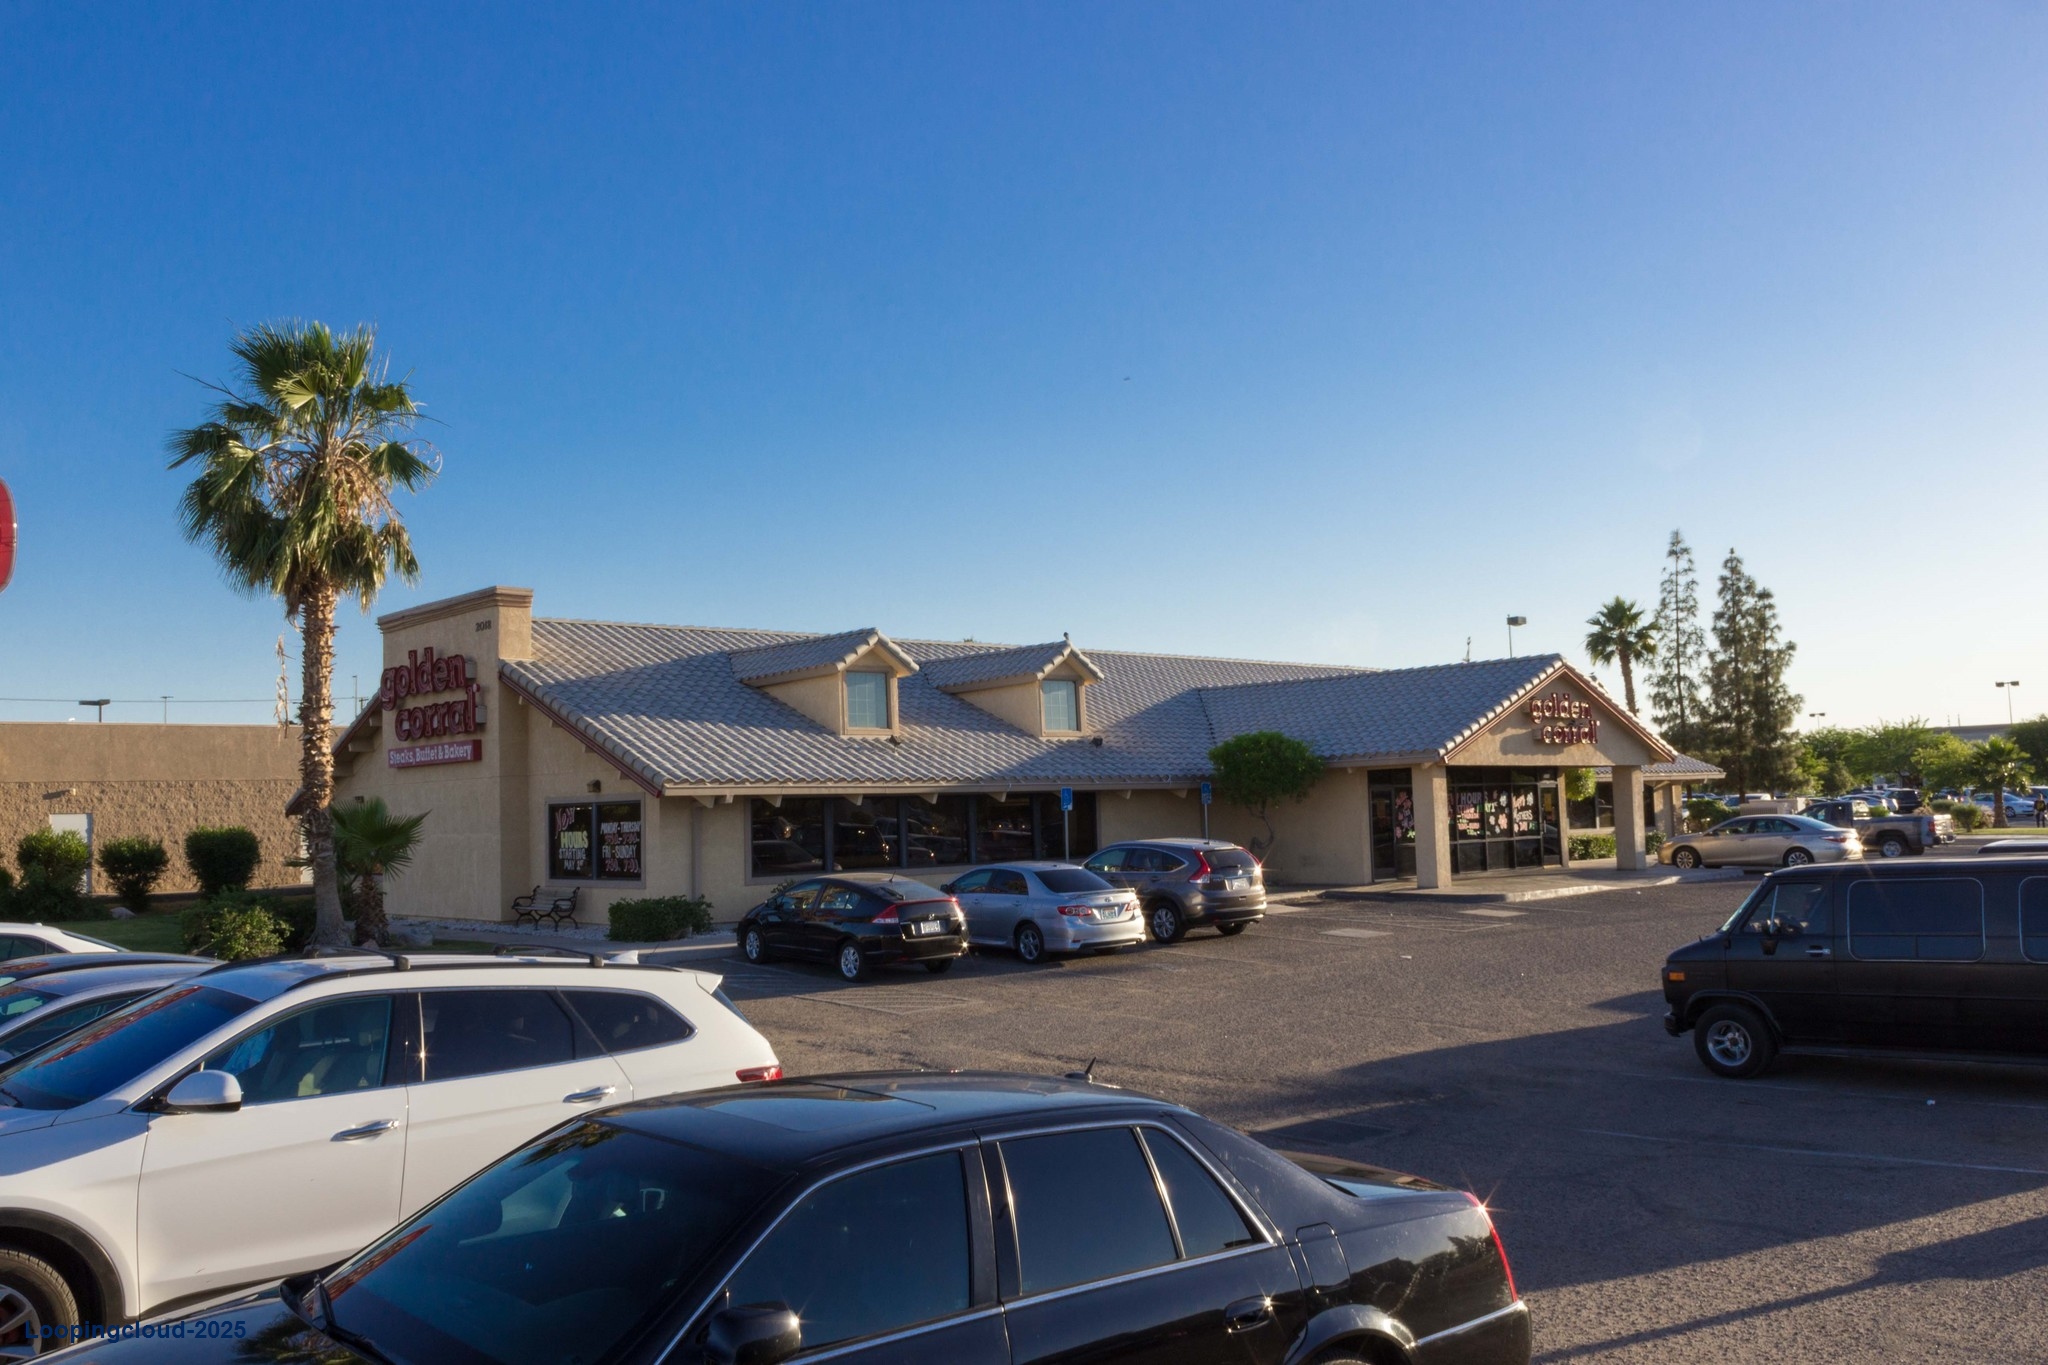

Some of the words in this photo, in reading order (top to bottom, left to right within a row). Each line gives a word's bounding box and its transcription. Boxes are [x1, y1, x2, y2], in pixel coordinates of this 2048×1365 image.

[380, 647, 467, 711] golden
[395, 687, 476, 741] corral
[1530, 693, 1592, 724] golden
[1543, 721, 1598, 744] corral
[416, 746, 437, 762] Buffet
[444, 744, 472, 760] Bakery
[560, 830, 589, 849] HOURS
